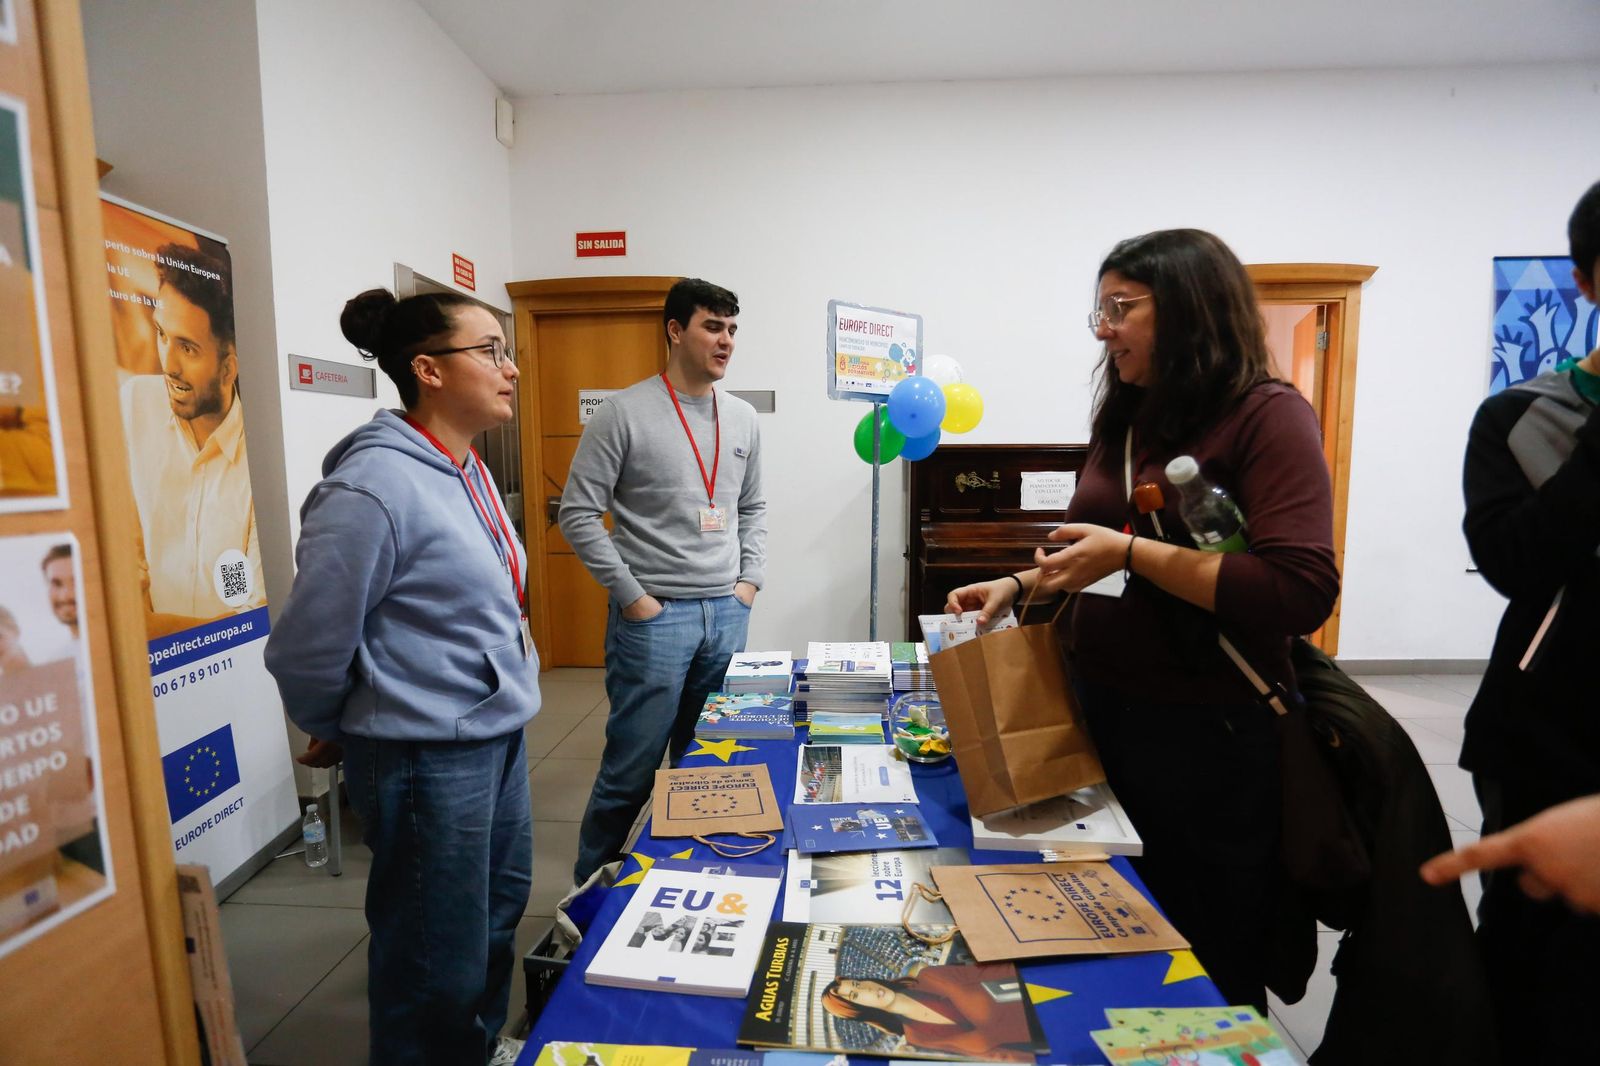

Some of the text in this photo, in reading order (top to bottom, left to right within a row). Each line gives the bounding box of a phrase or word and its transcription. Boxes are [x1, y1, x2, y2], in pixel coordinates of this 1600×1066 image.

[578, 239, 624, 250] SIN SALIDA
[117, 266, 131, 278] UE
[131, 247, 156, 262] sobre
[156, 253, 165, 264] la
[166, 256, 190, 274] Unión
[190, 264, 221, 281] Europea
[130, 293, 142, 304] de
[143, 295, 152, 307] la
[839, 317, 894, 338] EUROPE DIRECT
[315, 371, 349, 384] CAFETERIA
[170, 678, 178, 691] 6
[180, 675, 187, 688] 7
[189, 671, 197, 684] 8
[198, 668, 205, 681] 9
[207, 662, 220, 677] 10
[221, 657, 233, 672] 11
[25, 693, 58, 718] UE
[0, 750, 68, 792] ERPO
[712, 782, 756, 790] EUROPE
[175, 797, 244, 851] EUROPE DIRECT
[0, 825, 39, 855] AD
[882, 861, 891, 877] sobre
[894, 857, 903, 877] Europa
[650, 886, 748, 916] EU &
[875, 880, 903, 901] 12
[1051, 873, 1084, 901] DIRECT
[1067, 871, 1128, 937] Campo de Gibraltar
[627, 911, 745, 957] ME
[1076, 902, 1116, 938] EUROPE
[766, 937, 789, 979] TURBIAS
[755, 981, 779, 1022] AGUAS
